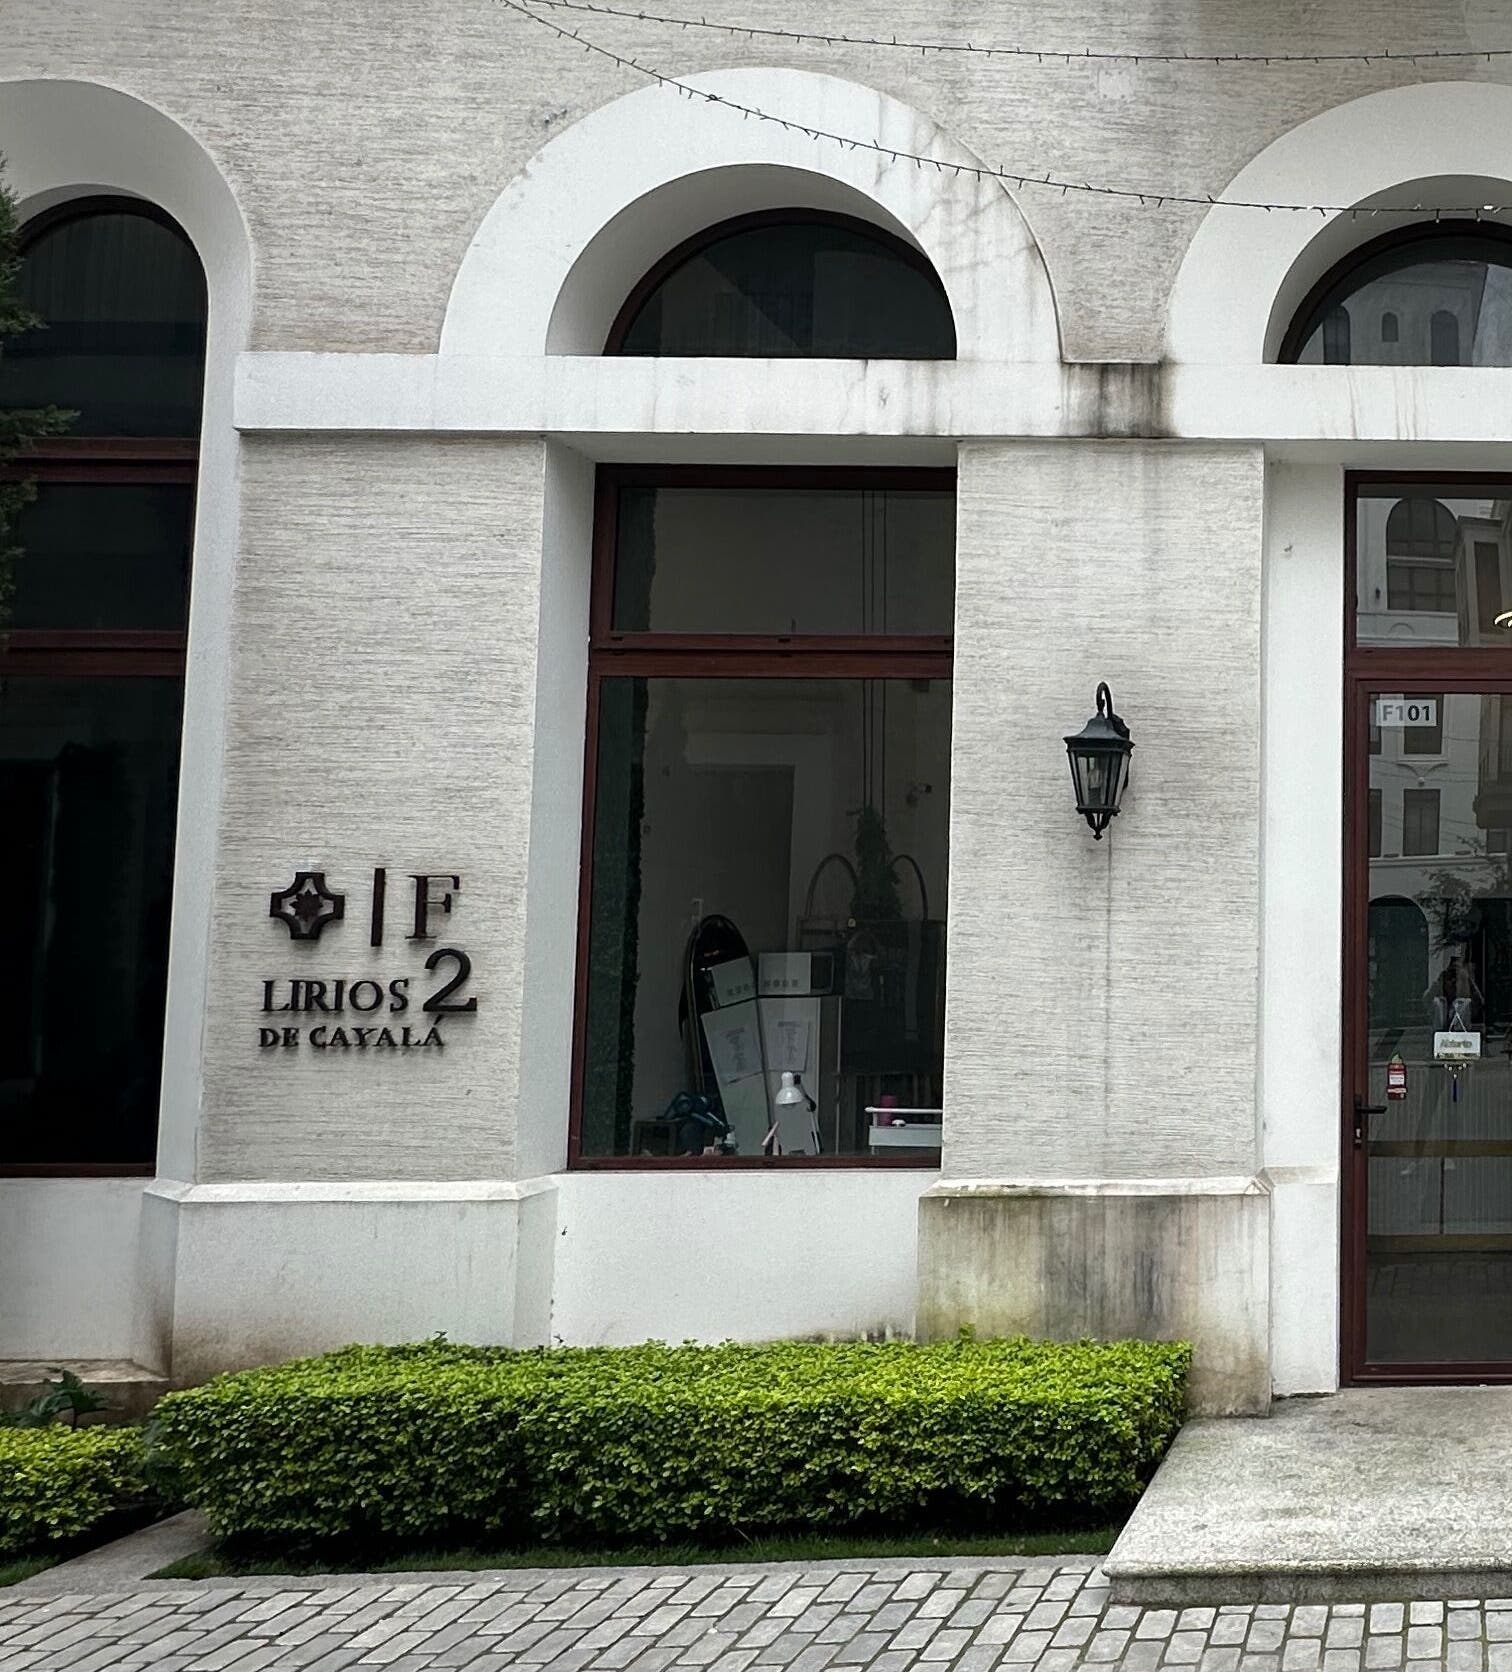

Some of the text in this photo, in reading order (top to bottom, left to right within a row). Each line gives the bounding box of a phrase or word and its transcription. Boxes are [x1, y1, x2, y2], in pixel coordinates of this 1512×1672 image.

[1383, 705, 1430, 721] F101
[405, 875, 460, 940] F
[261, 979, 409, 1012] LIRIOS
[422, 948, 477, 1012] 2
[258, 1014, 445, 1048] DE CAYALÁ
